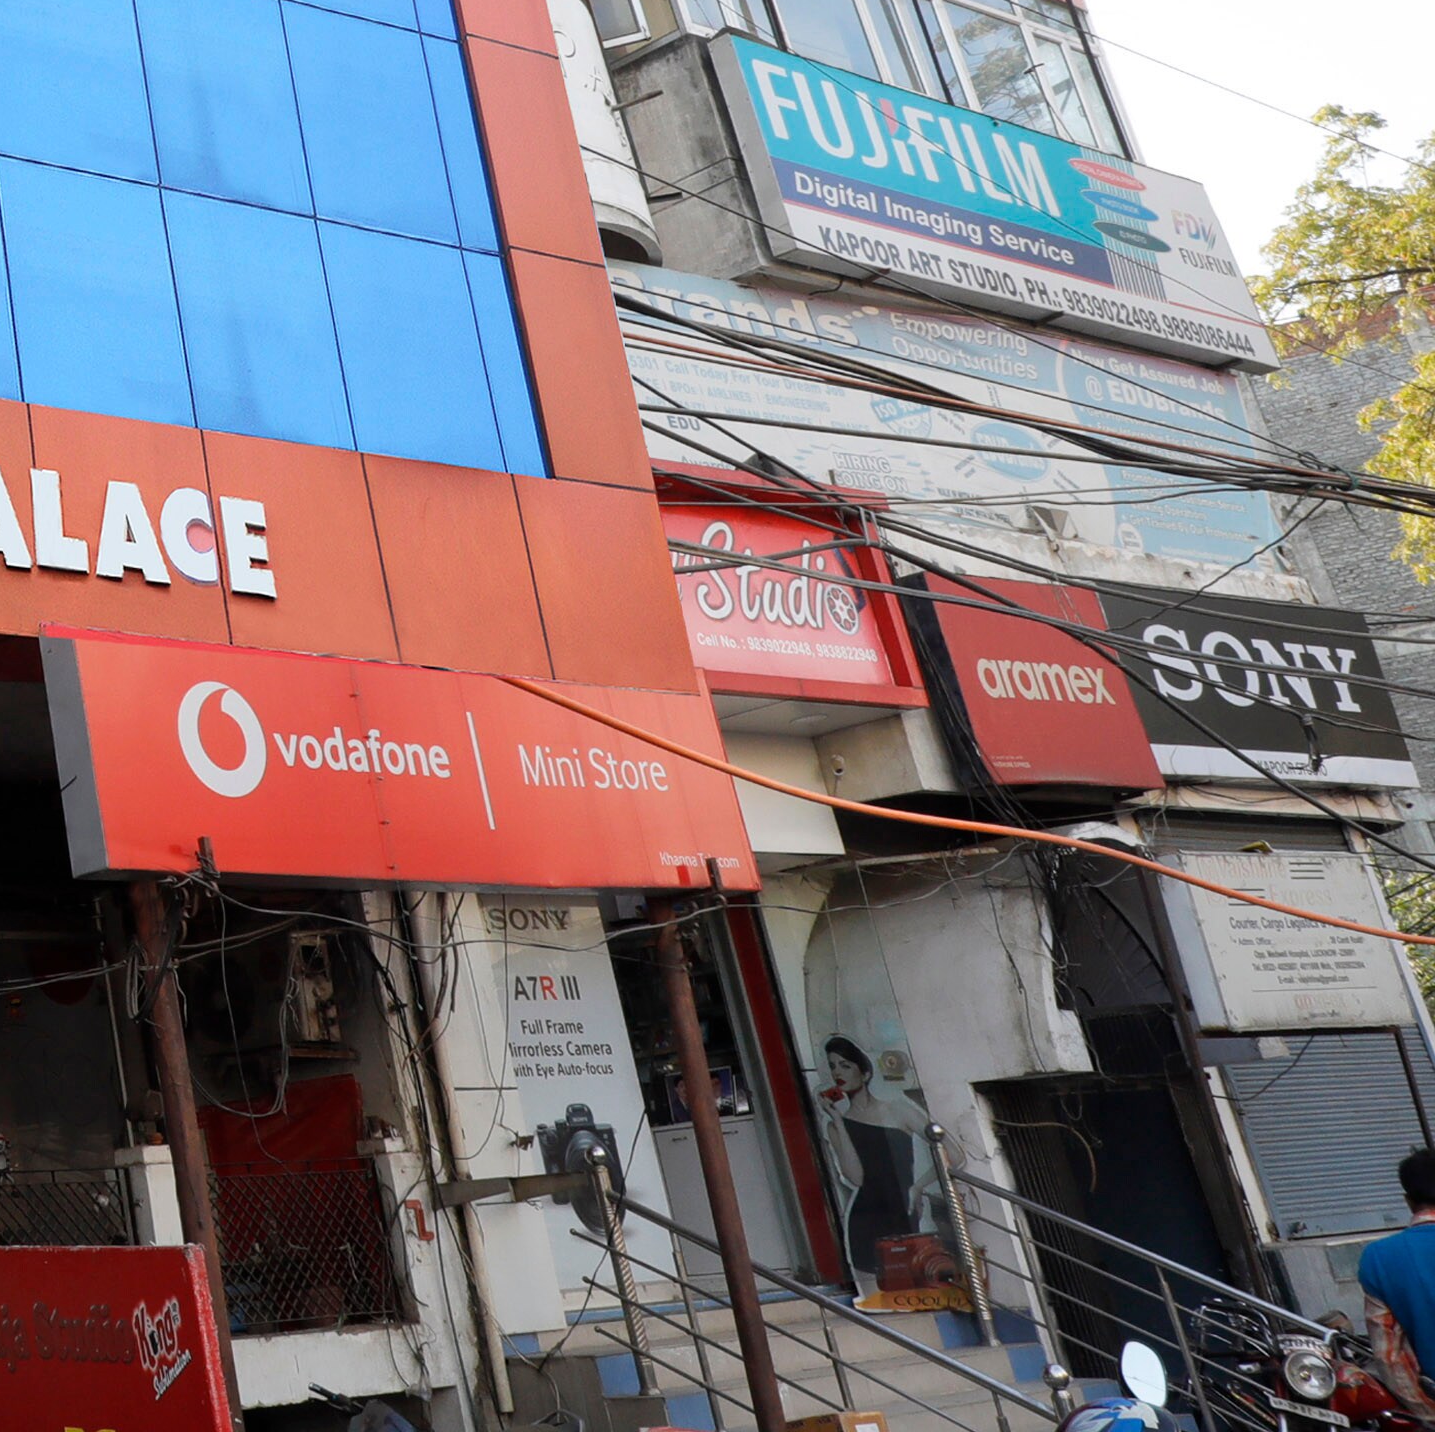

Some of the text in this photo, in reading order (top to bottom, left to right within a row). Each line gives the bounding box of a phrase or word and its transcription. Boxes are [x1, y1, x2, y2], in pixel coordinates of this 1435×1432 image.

[752, 58, 1061, 217] FUJIFILM
[794, 171, 1075, 266] Digital Imaging Service
[817, 224, 1023, 308] KAPOOR ART STUDIO,
[889, 312, 1028, 358] Empowering
[890, 335, 1039, 382] Opportunities
[1071, 348, 1226, 396] Now Get Assured Job
[665, 359, 690, 376] Call
[693, 364, 729, 384] Today
[732, 371, 751, 387] For
[753, 373, 781, 390] Your
[1084, 376, 1103, 400] @
[667, 415, 701, 432] EDU
[832, 451, 891, 474] HIRING
[886, 476, 909, 493] ON
[697, 632, 719, 648] Cell
[977, 658, 1116, 705] aramex
[1142, 624, 1361, 713] SONY
[273, 725, 452, 779] vodafone
[517, 744, 669, 793] Mini Store
[659, 851, 698, 868] Khanna
[487, 907, 569, 931] SONY
[514, 975, 559, 1002] A7R
[521, 1020, 584, 1035] Full Frame
[566, 1042, 613, 1057] Camera
[536, 1064, 555, 1078] Eye
[557, 1062, 614, 1077] Auto-focus
